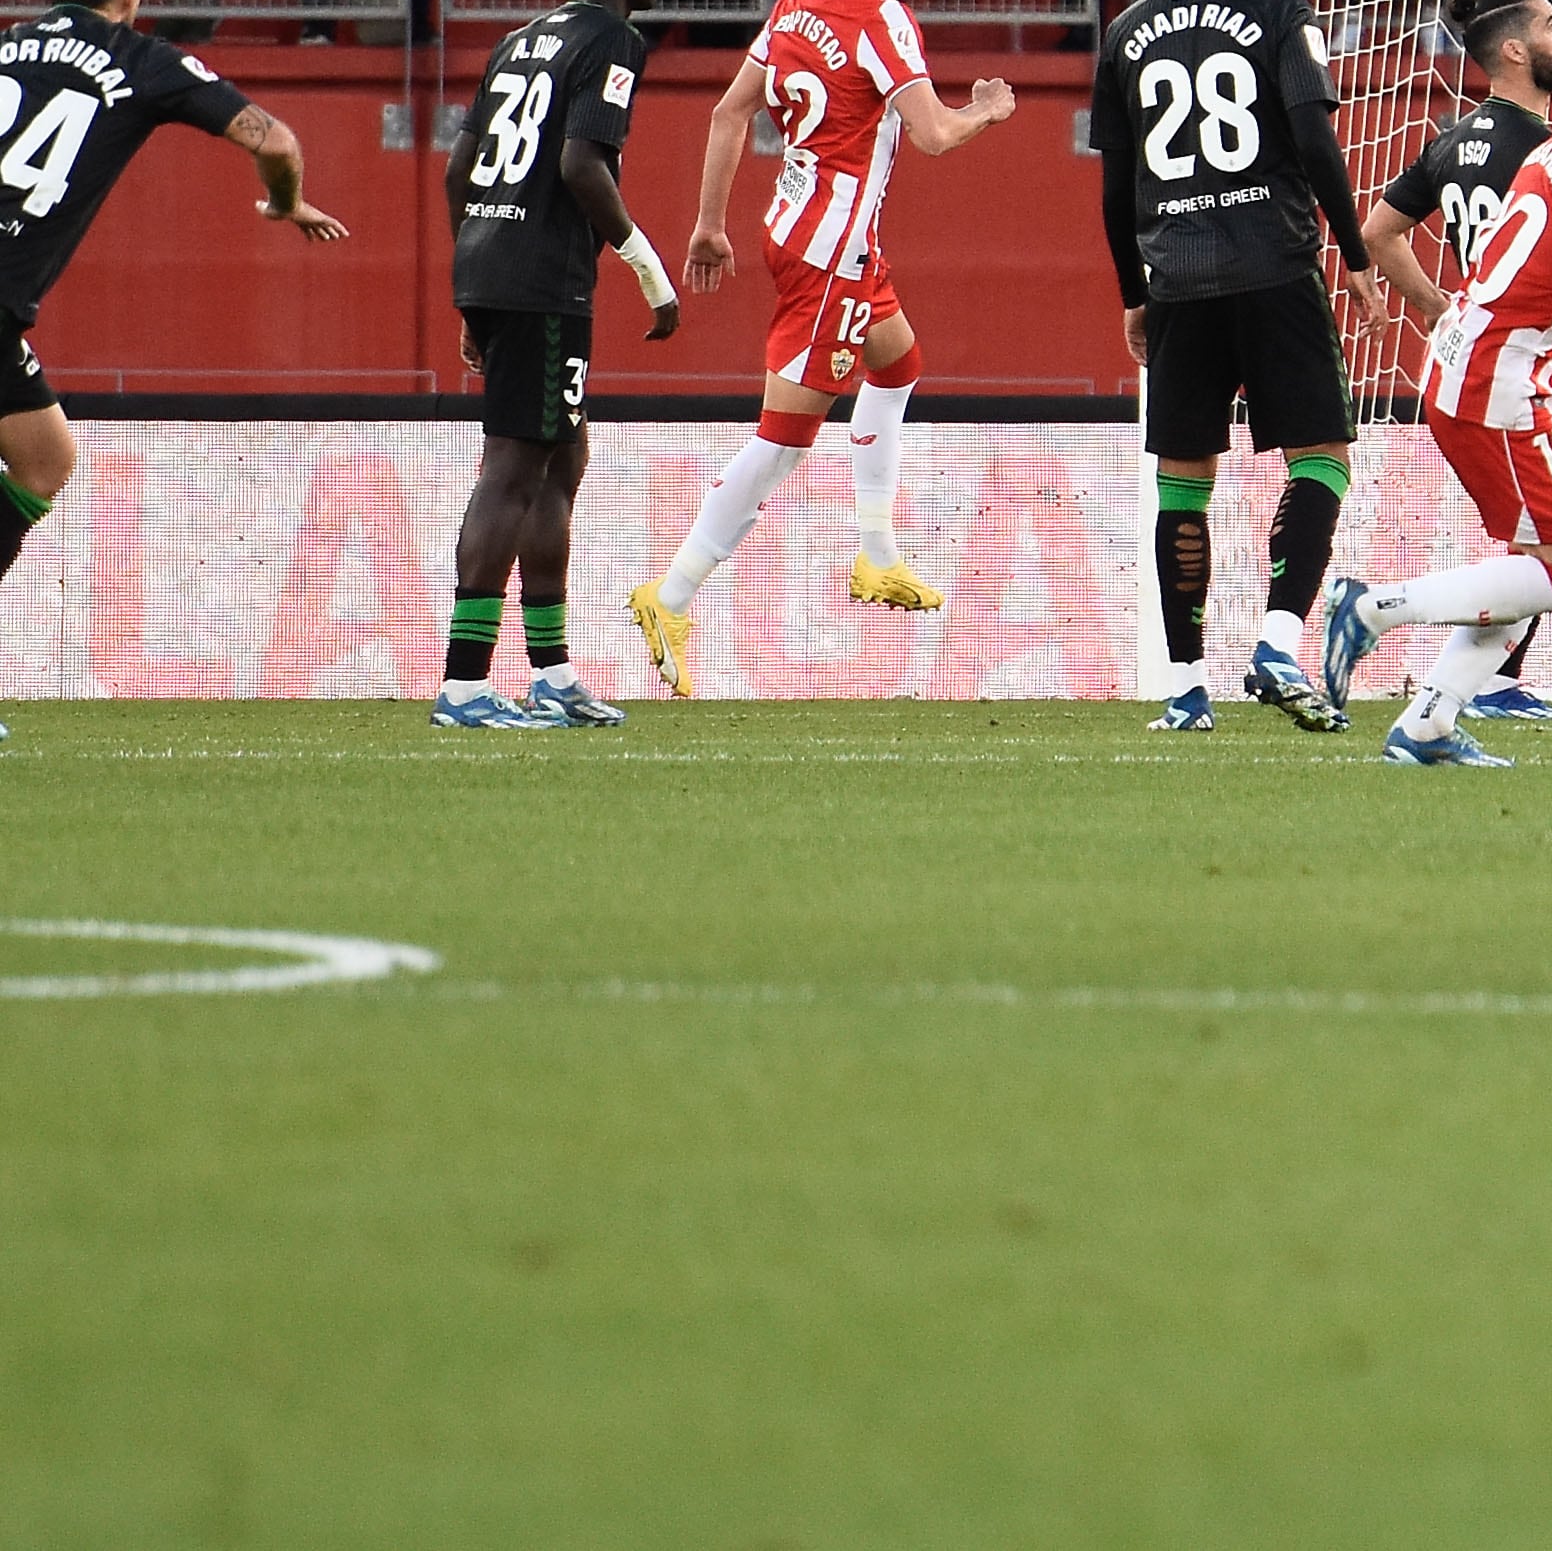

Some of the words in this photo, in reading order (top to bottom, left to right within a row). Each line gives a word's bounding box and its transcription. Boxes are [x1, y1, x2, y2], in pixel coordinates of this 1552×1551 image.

[1124, 4, 1199, 62] CHADI
[1200, 3, 1264, 48] RIAD
[41, 37, 134, 109] RUIBAL
[469, 70, 553, 188] 38
[1139, 51, 1260, 182] 28
[1458, 140, 1491, 167] ISCO
[1219, 185, 1271, 208] GREEN
[836, 296, 872, 345] 12
[563, 356, 589, 406] 3
